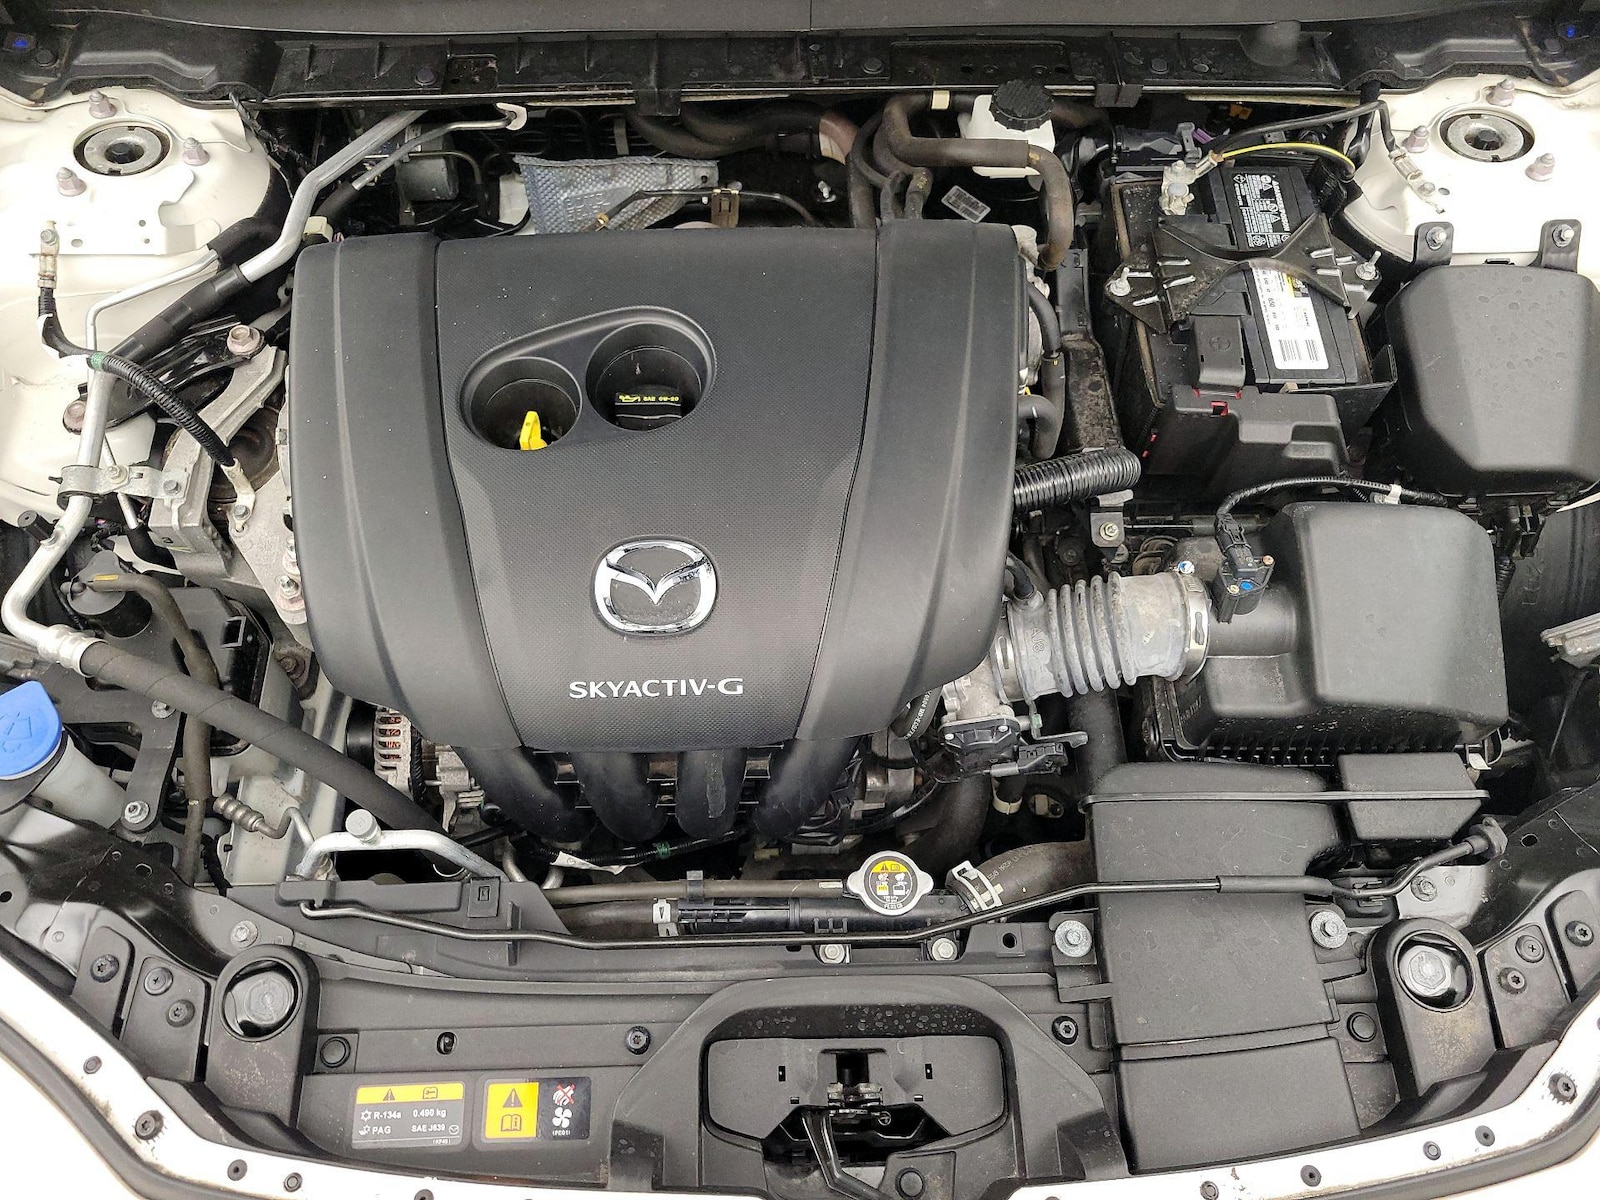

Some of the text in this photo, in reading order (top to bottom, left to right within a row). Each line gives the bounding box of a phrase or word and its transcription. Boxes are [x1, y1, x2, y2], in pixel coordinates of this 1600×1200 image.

[569, 678, 744, 699] SKYACTIV-G
[373, 1108, 447, 1120] R-134a 0.490 kg
[372, 1123, 446, 1135] PAG SAE J639
